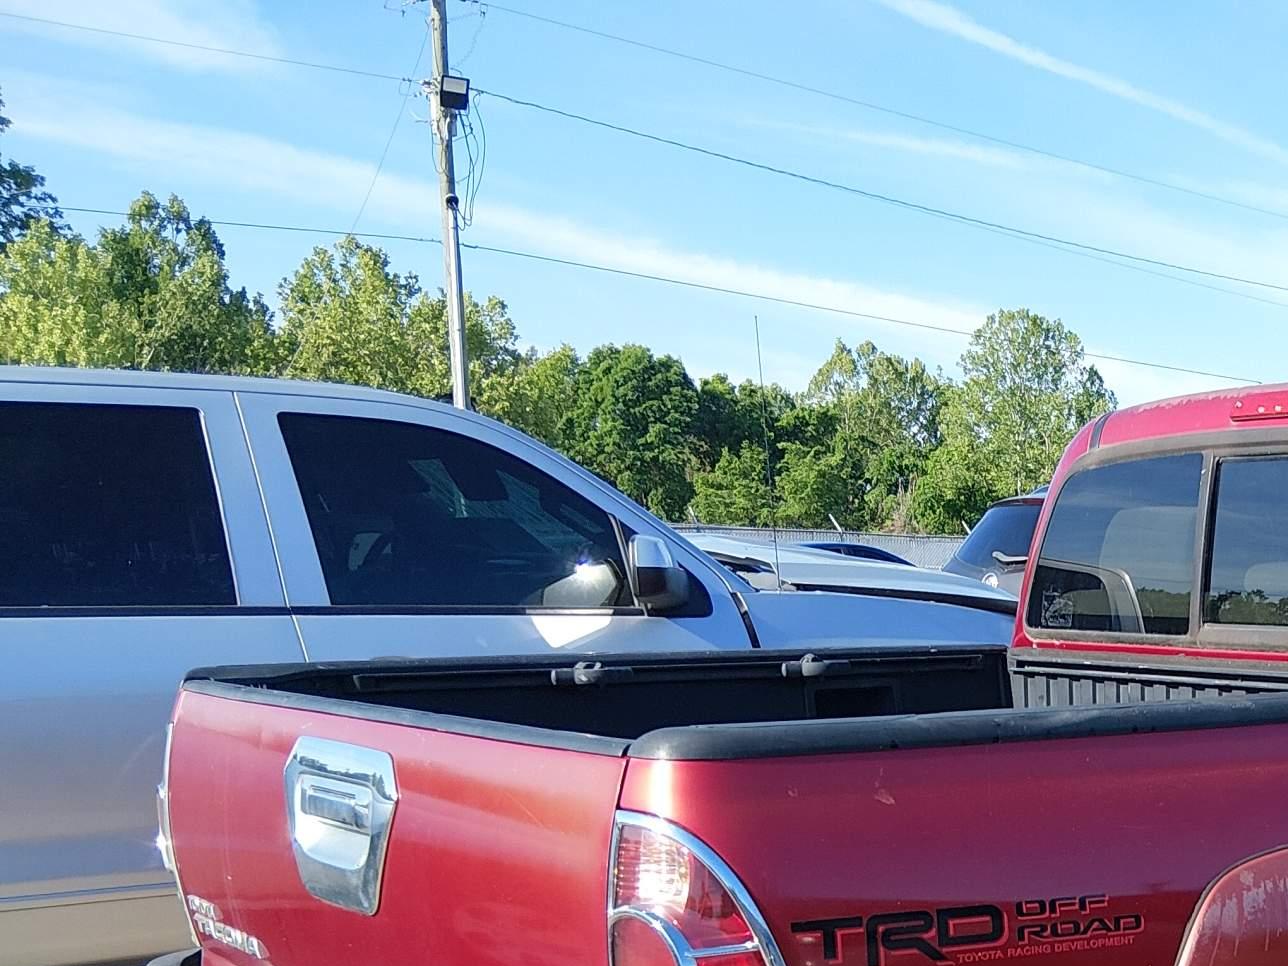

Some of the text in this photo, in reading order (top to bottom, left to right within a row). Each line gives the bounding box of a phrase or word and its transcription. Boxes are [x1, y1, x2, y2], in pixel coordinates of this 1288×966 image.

[1016, 894, 1109, 919] OFF
[193, 913, 263, 959] TACOMA
[1016, 913, 1145, 944] ROAD
[957, 936, 1134, 964] TOYOTA RACING DEVELOPMENT
